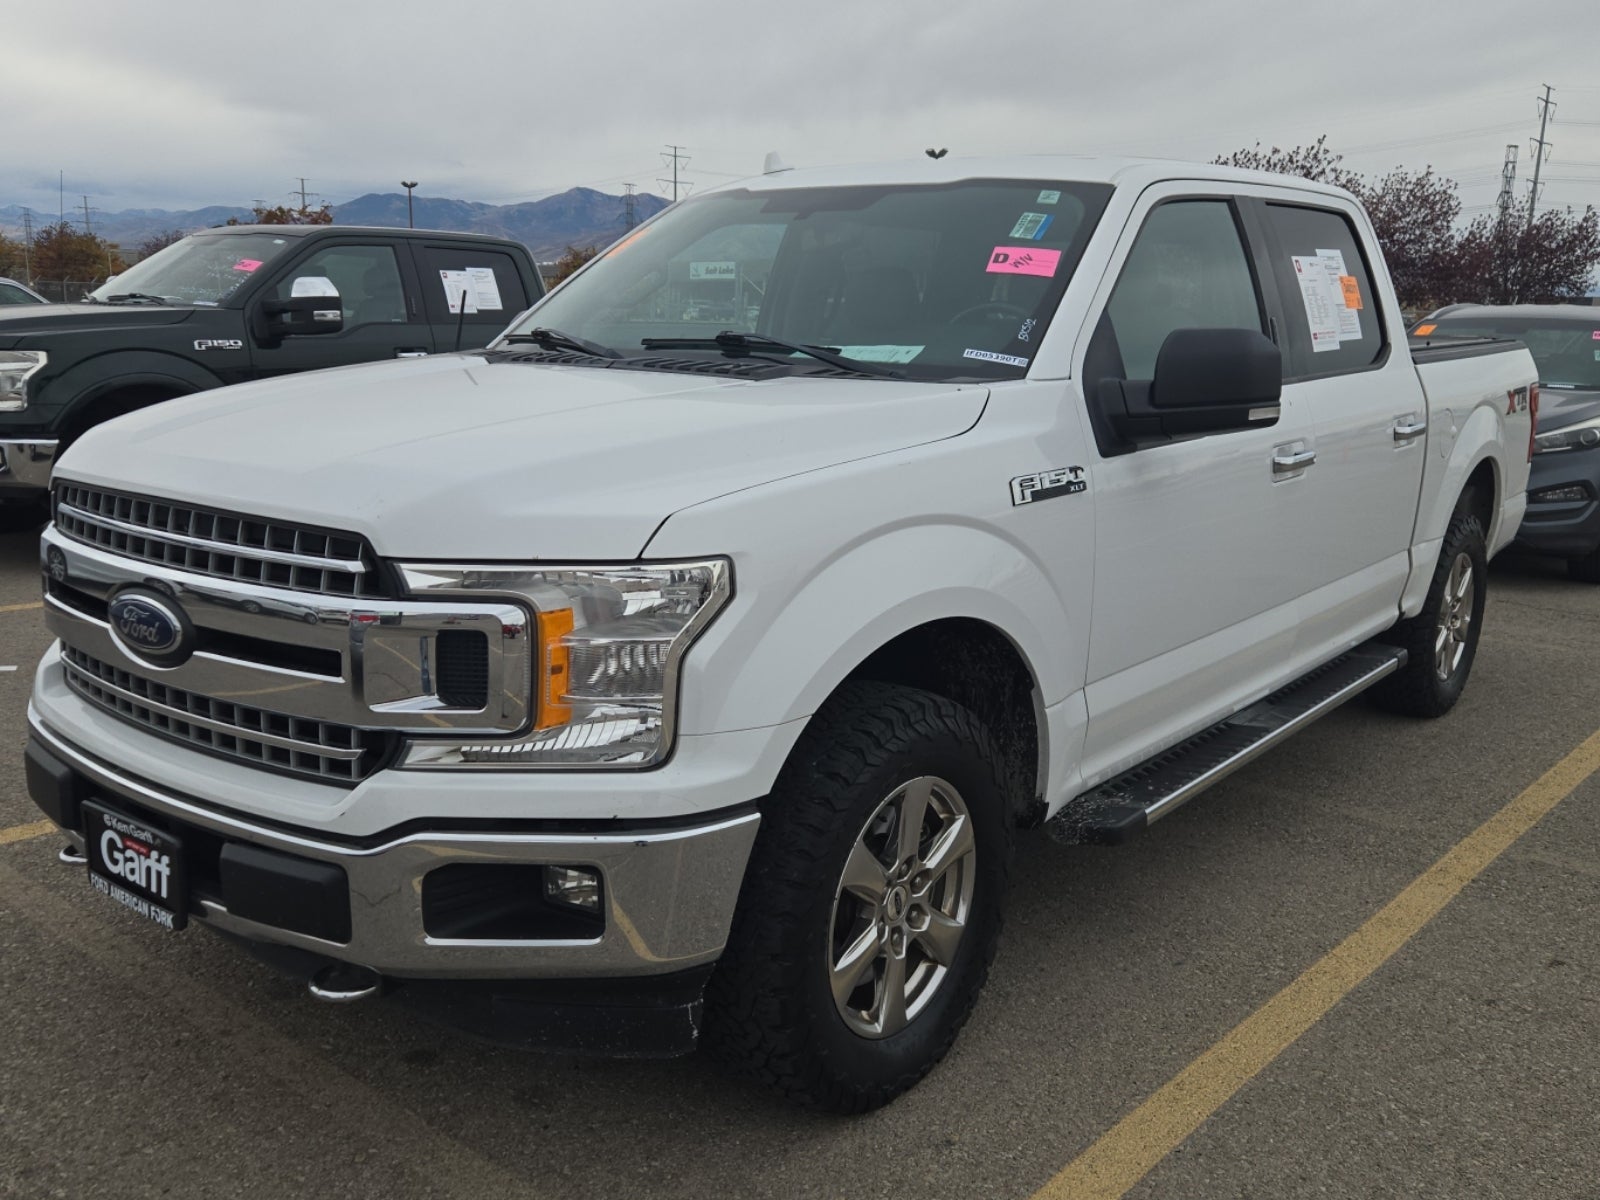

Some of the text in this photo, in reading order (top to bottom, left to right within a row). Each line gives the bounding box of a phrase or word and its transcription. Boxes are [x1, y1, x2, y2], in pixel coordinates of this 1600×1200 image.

[1069, 482, 1084, 493] XLT
[119, 605, 161, 643] Ford
[100, 828, 171, 899] Garff
[90, 873, 175, 930] FORD AMERICAN FORK
